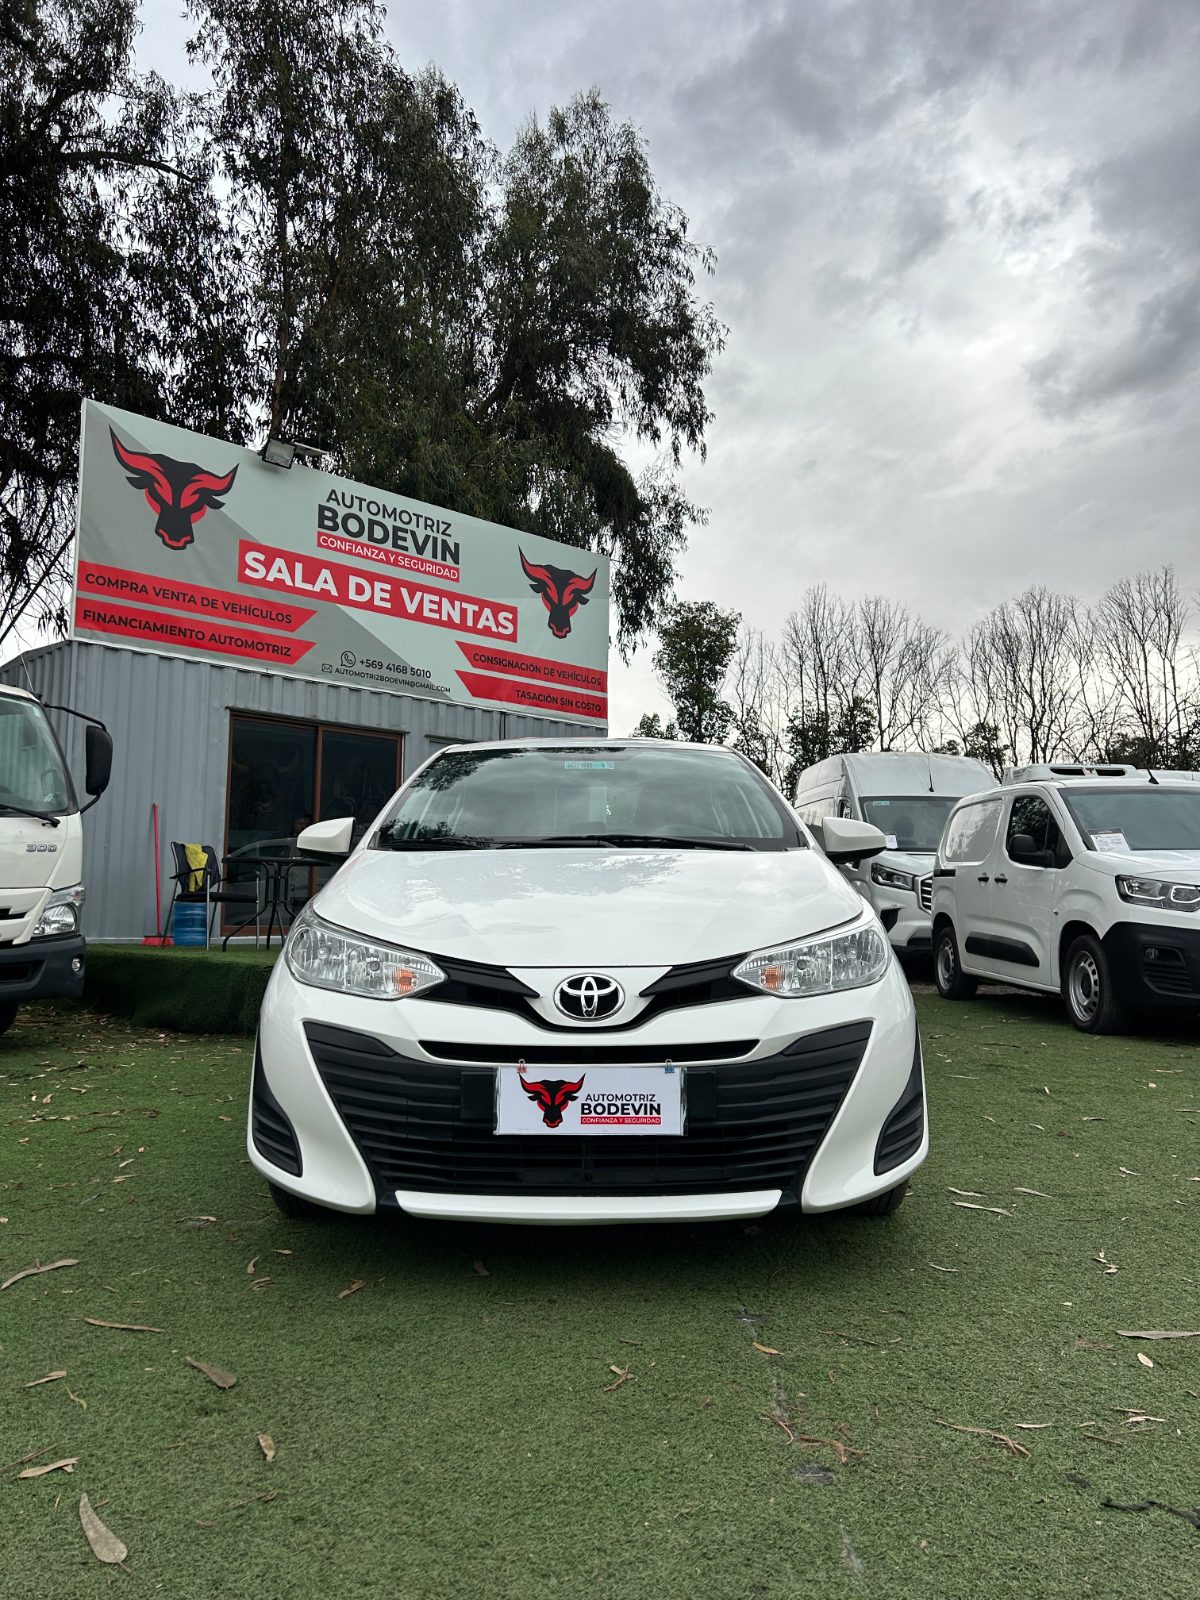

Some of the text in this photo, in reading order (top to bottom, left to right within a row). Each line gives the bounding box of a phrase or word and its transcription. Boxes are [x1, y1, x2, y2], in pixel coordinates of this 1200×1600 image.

[326, 488, 452, 537] AUTOMOTRIZ
[317, 503, 460, 565] BODEVIN
[319, 535, 458, 579] CONFIANZA Y SEGURIDAD
[85, 573, 292, 624] COMPRA VENTA DE VEHÍCULOS
[244, 550, 515, 635] SALA DE VENTAS
[83, 609, 291, 656] FINANCIAMIENTO AUTOMOTRIZ
[359, 658, 431, 679] +569 4168 5010
[473, 653, 602, 686] CONSIGNACIÓN DE VEHÍCULOS
[516, 689, 601, 712] TASACIÓN SIN COSTO
[26, 844, 58, 853] 300
[580, 1102, 661, 1116] BODEVIN
[585, 1093, 656, 1102] AUTOMOTRIZ
